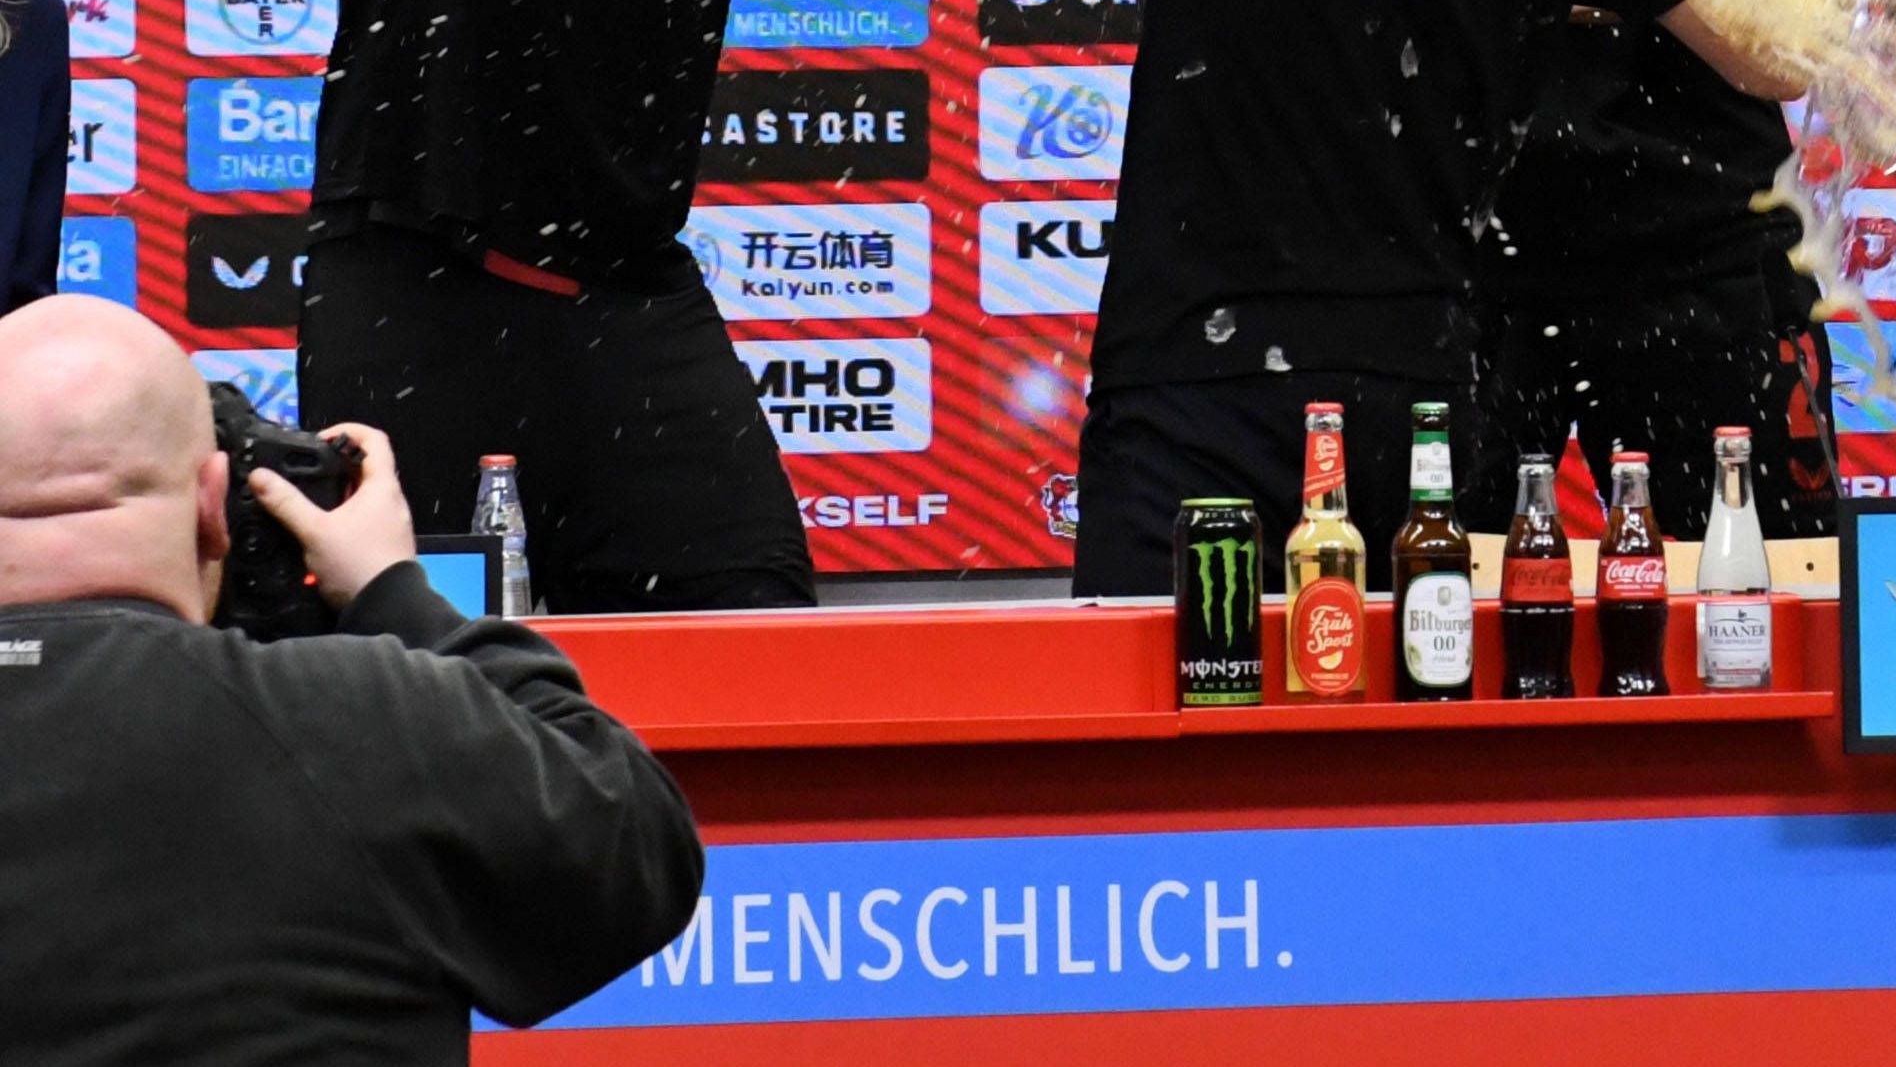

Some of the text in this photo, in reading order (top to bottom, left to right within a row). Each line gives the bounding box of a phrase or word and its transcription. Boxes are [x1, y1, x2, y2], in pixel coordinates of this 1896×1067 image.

[741, 231, 895, 270] 开云体育
[769, 403, 895, 433] TIRE
[1409, 609, 1472, 634] Bitburge
[641, 879, 1294, 987] MENSCHLICH.
